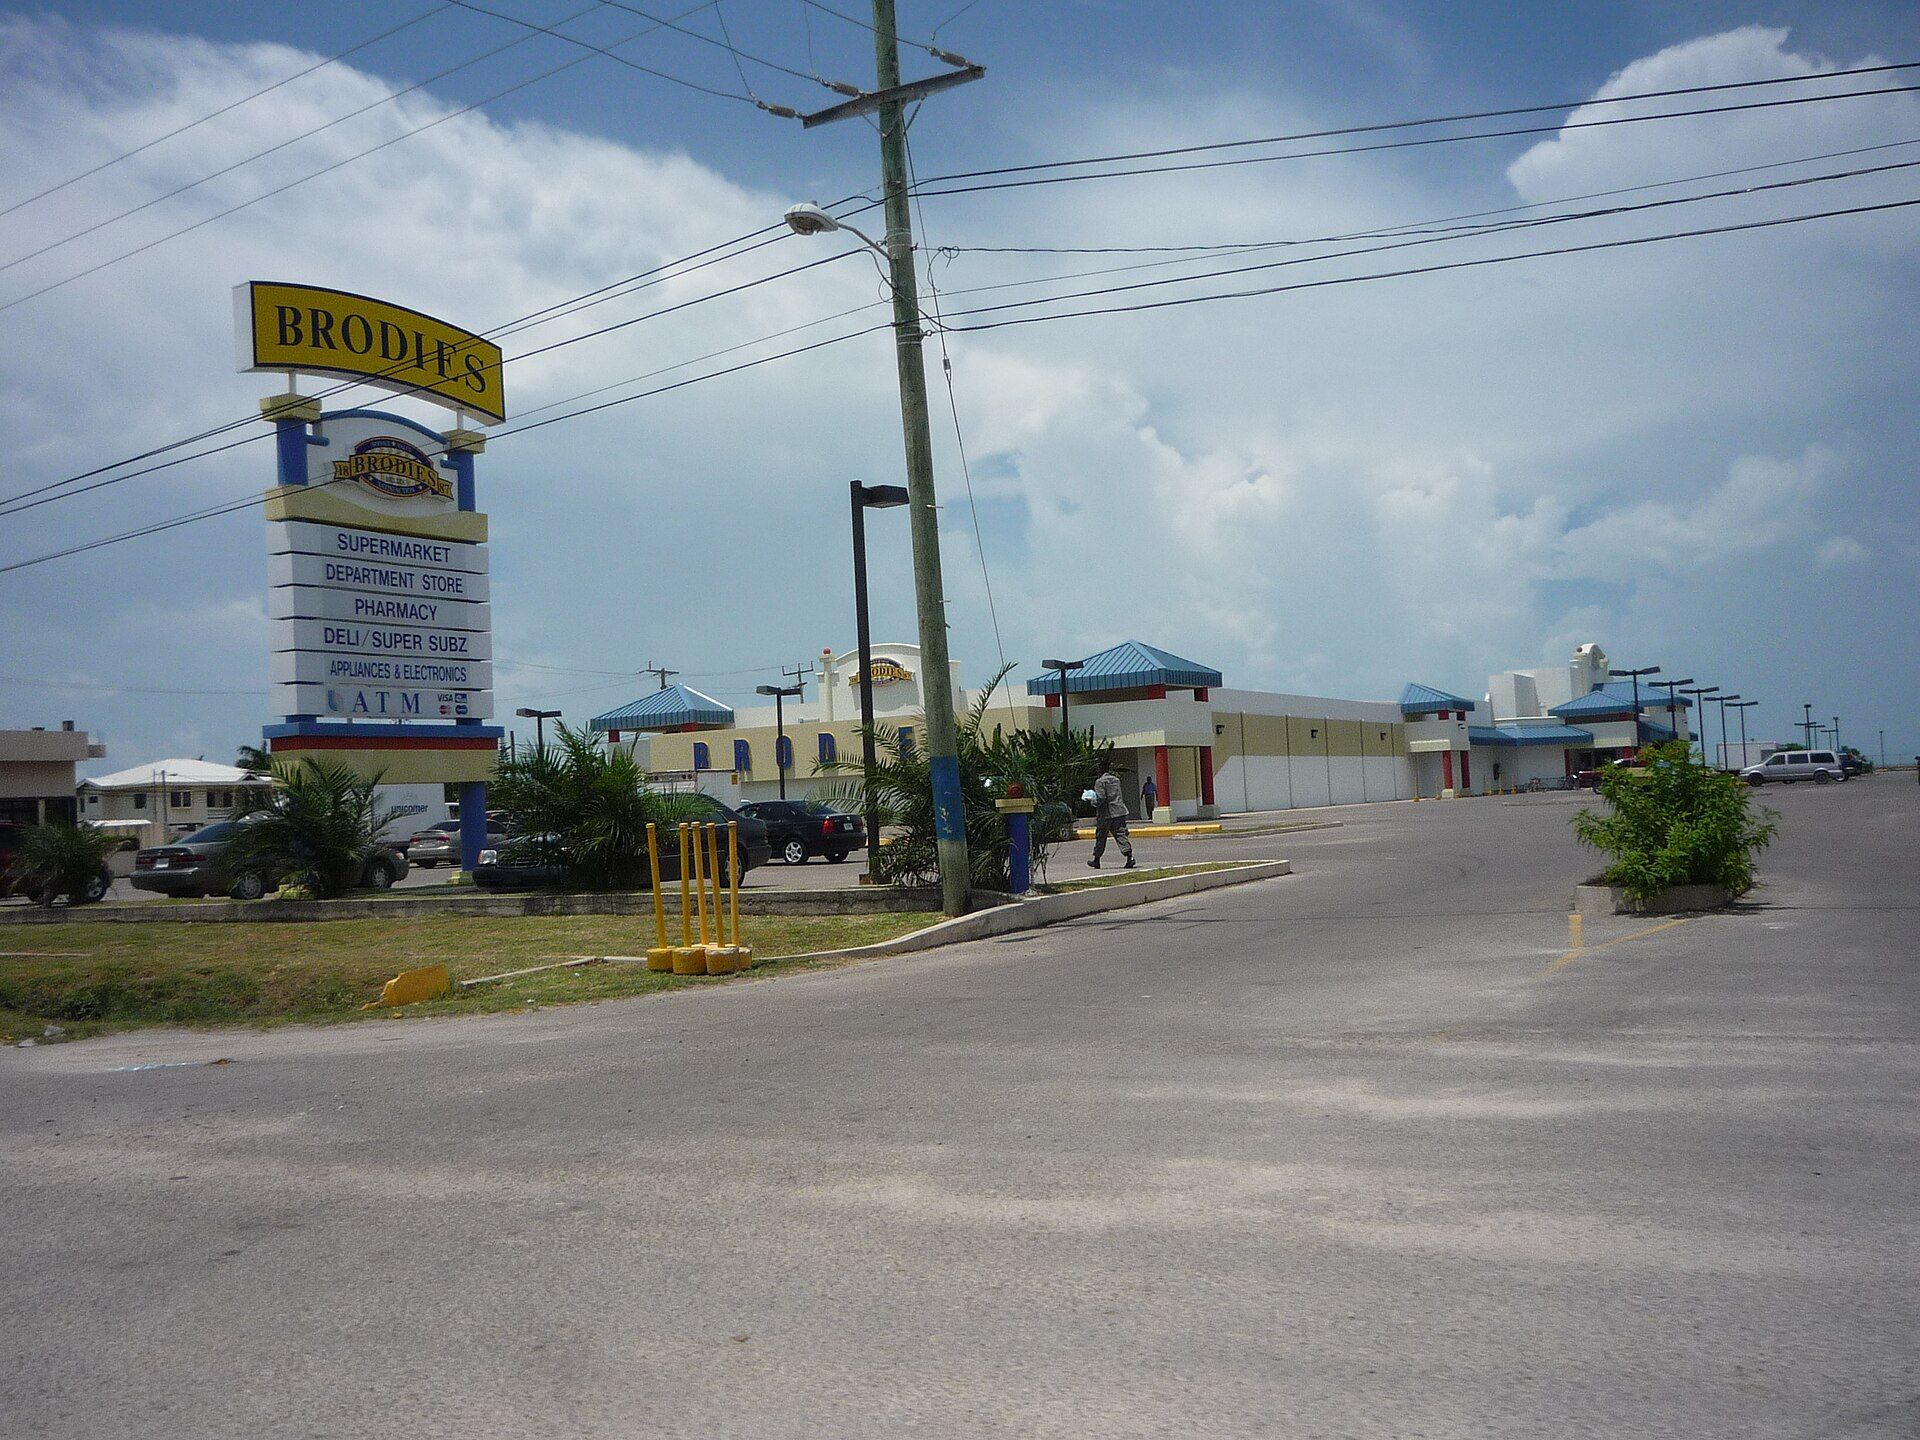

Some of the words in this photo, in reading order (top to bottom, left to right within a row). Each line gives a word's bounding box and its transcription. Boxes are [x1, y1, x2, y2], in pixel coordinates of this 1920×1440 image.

[275, 305, 486, 393] BRODIES
[339, 464, 349, 476] 18
[354, 456, 437, 487] BRODIES
[338, 533, 451, 562] SUPERMARKET
[326, 563, 415, 589] DEPARTMENT
[422, 574, 463, 593] STORE
[355, 598, 438, 621] PHARMACY
[429, 635, 468, 653] SUBZ
[330, 660, 391, 679] APPLIANCES
[394, 665, 400, 679] &
[403, 664, 467, 682] ELECTRONICS
[352, 690, 422, 714] ATM
[437, 693, 453, 702] VISA
